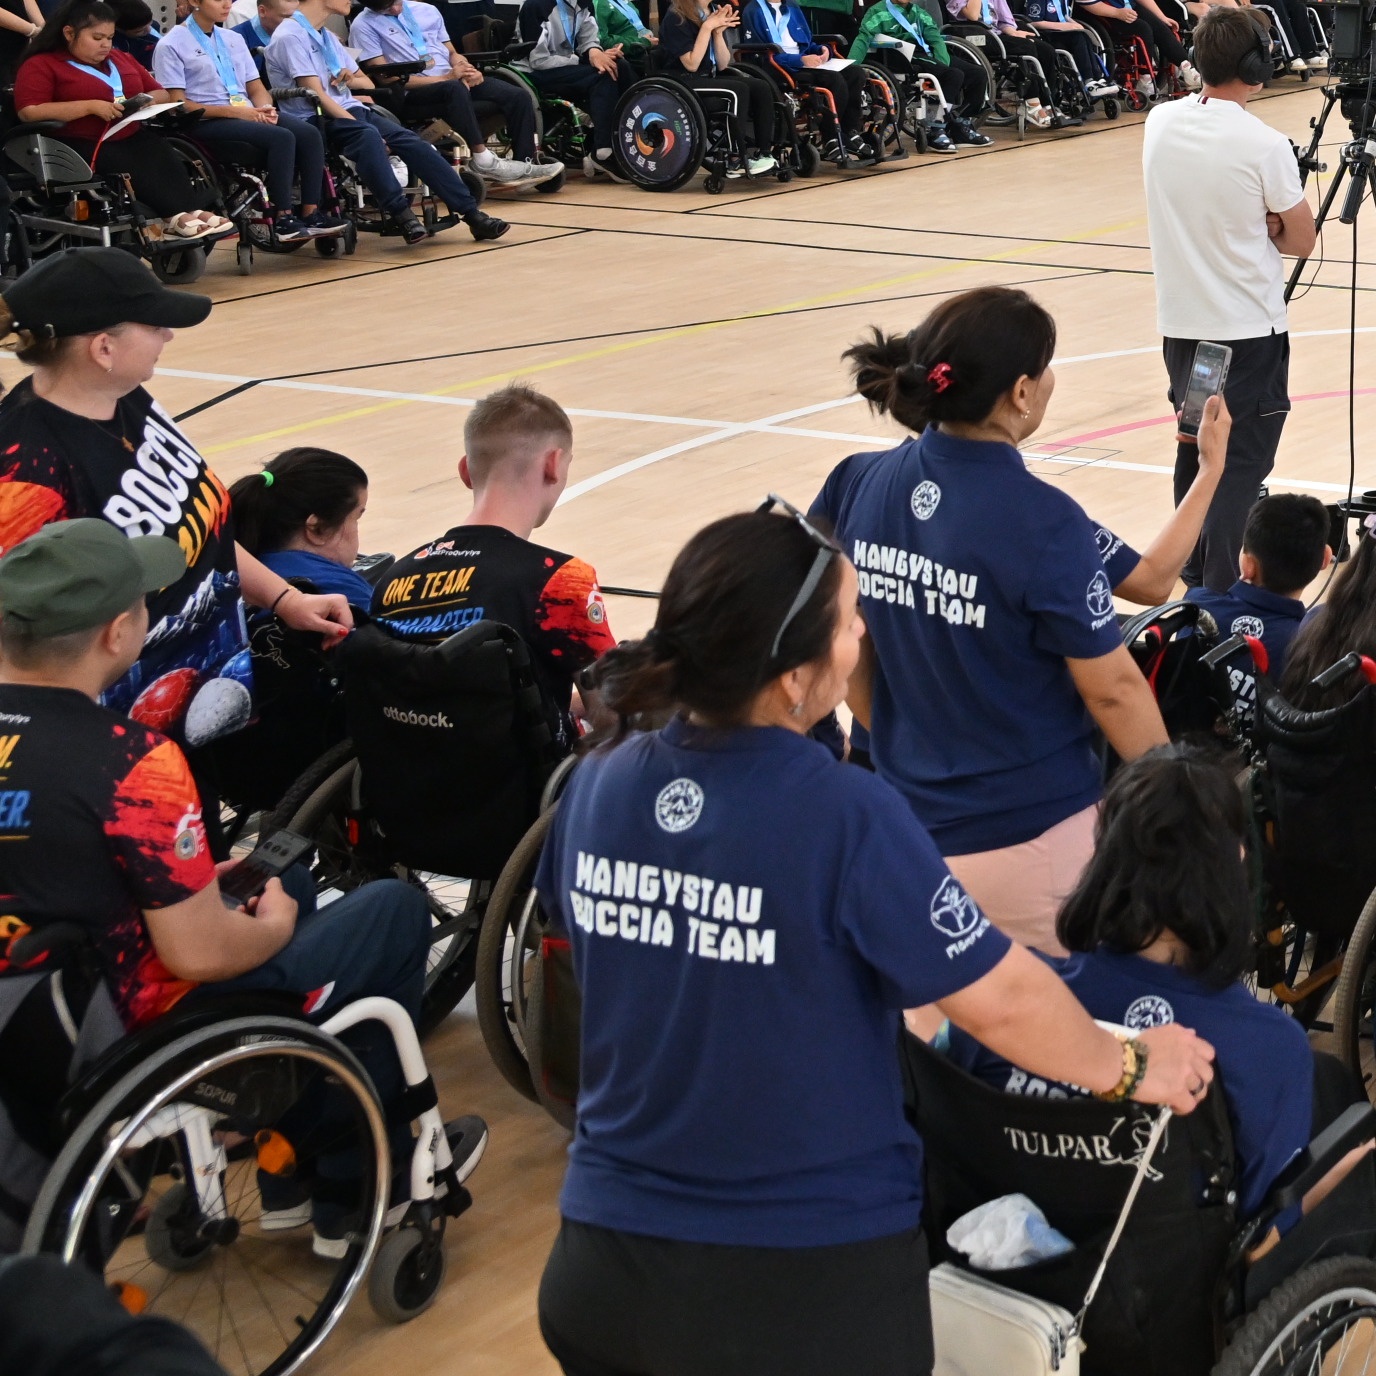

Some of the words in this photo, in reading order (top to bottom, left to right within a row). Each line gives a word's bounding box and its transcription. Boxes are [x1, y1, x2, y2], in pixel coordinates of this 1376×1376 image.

[382, 574, 421, 606] ONE
[420, 566, 476, 599] TEAM.
[853, 539, 978, 600] MANGYSTAU
[857, 570, 916, 610] OCCIA
[924, 589, 987, 629] TEAM
[383, 705, 454, 728] ottobock.
[575, 850, 763, 924] MANGYSTAU
[569, 890, 675, 947] BOCCIA
[687, 914, 777, 966] TEAM
[1003, 1126, 1115, 1160] TULPAR
